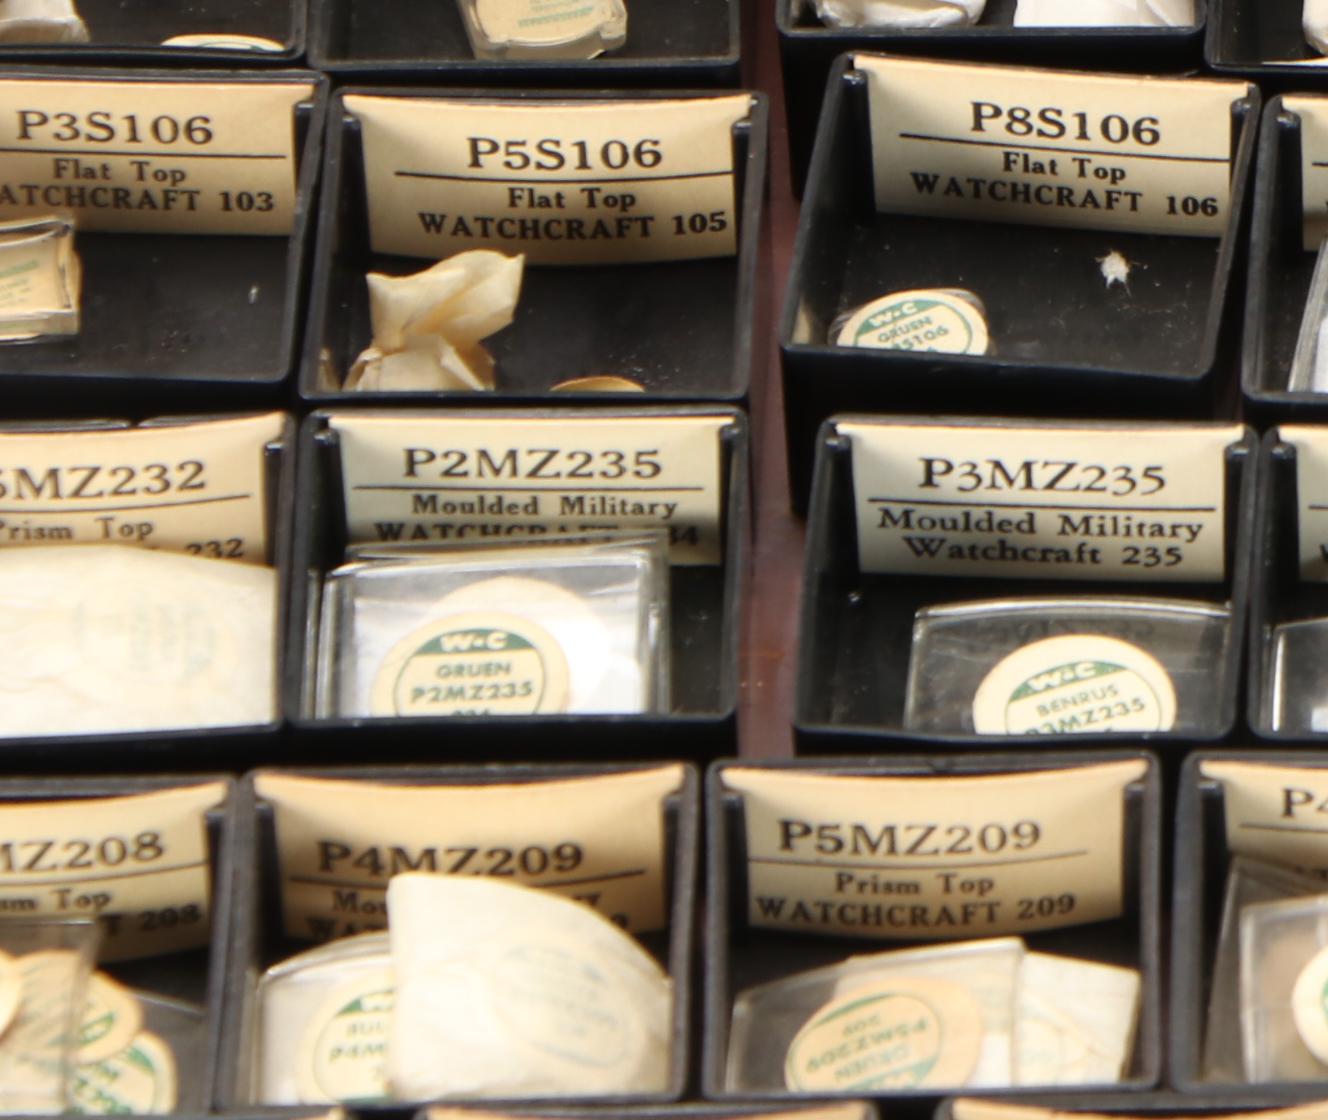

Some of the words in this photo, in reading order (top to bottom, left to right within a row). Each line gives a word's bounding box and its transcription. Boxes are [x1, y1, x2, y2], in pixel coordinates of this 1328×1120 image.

[19, 111, 212, 144] P3S106
[972, 102, 1160, 145] P8S106
[468, 138, 662, 170] P5S106
[1003, 152, 1057, 175] Flat
[1072, 158, 1125, 185] Top
[55, 159, 109, 180] Flat
[131, 161, 185, 186] Top
[509, 188, 564, 208] Flat
[581, 188, 635, 212] Top
[911, 167, 1142, 211] WATCHCRAFT
[1167, 196, 1218, 216] 106
[878, 317, 932, 342] GRUEN
[406, 449, 661, 478] P2MZ235
[920, 459, 1165, 495] P3MZ235
[414, 495, 538, 514] Moulded
[562, 496, 676, 519] Military
[103, 518, 152, 542] Top
[879, 508, 1035, 534] Moulded
[1058, 515, 1202, 542] Military
[904, 537, 1099, 564] Watchcraft
[1123, 547, 1182, 567] 235
[435, 661, 512, 680] GRUEN
[410, 682, 533, 704] P2MZ235
[1036, 684, 1119, 716] BENRUS
[780, 820, 1039, 854] P5MZ209
[320, 842, 582, 876] P4MZ209
[59, 890, 109, 908] Top
[837, 873, 918, 893] Prism
[936, 875, 993, 896] Top
[759, 899, 995, 925] WATCHCRAFT
[1020, 895, 1074, 918] 209
